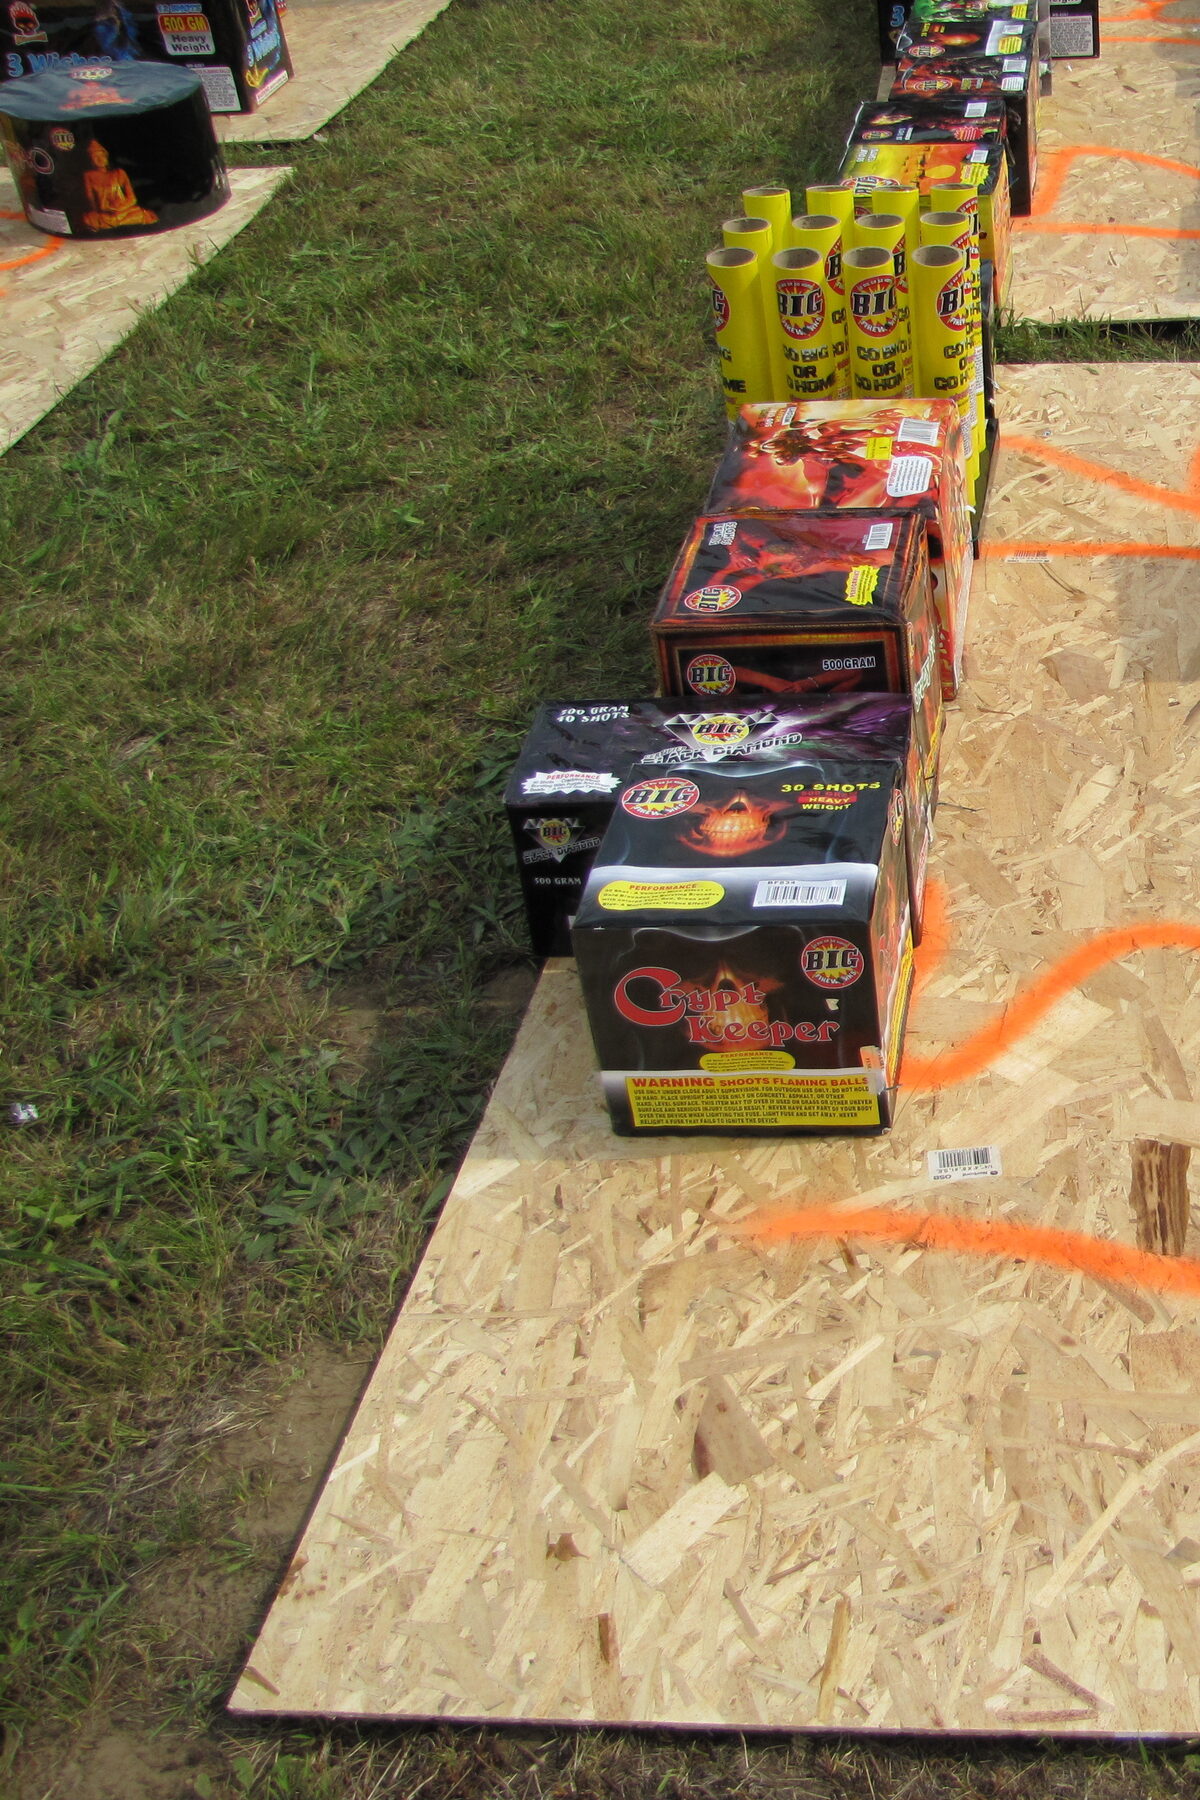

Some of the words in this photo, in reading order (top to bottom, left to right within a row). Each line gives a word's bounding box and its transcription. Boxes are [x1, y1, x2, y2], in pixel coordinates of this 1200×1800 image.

[164, 17, 184, 31] 500
[171, 34, 208, 43] Heavy
[171, 43, 212, 53] Weight
[7, 52, 24, 78] 3
[777, 288, 823, 317] BIG
[856, 346, 880, 361] GO
[943, 343, 963, 361] GO
[793, 365, 818, 378] OR
[872, 361, 896, 377] OR
[934, 376, 959, 391] GO
[699, 588, 721, 610] BIG
[822, 658, 842, 671] 500
[843, 656, 876, 670] GRAM
[690, 665, 732, 683] BIG
[560, 707, 586, 715] 500
[590, 705, 630, 714] GRAM
[580, 711, 630, 723] SHOTS
[693, 722, 747, 735] BIG
[712, 732, 803, 757] DIAMOND
[780, 783, 805, 793] 30
[812, 781, 881, 793] SHOTS
[624, 785, 695, 805] BIG
[808, 796, 851, 804] HEAVY
[801, 803, 852, 811] WEIGHT
[542, 825, 568, 837] BIG
[556, 837, 601, 856] DIAMOND
[534, 876, 552, 885] 500
[554, 876, 582, 885] GRAM
[629, 883, 698, 891] PERFORMANCE
[803, 948, 859, 972] BIG
[614, 966, 766, 1027] Crypt
[684, 1015, 840, 1047] Keeper
[632, 1077, 715, 1088] WARNING
[719, 1077, 770, 1087] SHOOTS
[773, 1077, 827, 1087] FLAMING
[830, 1077, 869, 1086] BALLS
